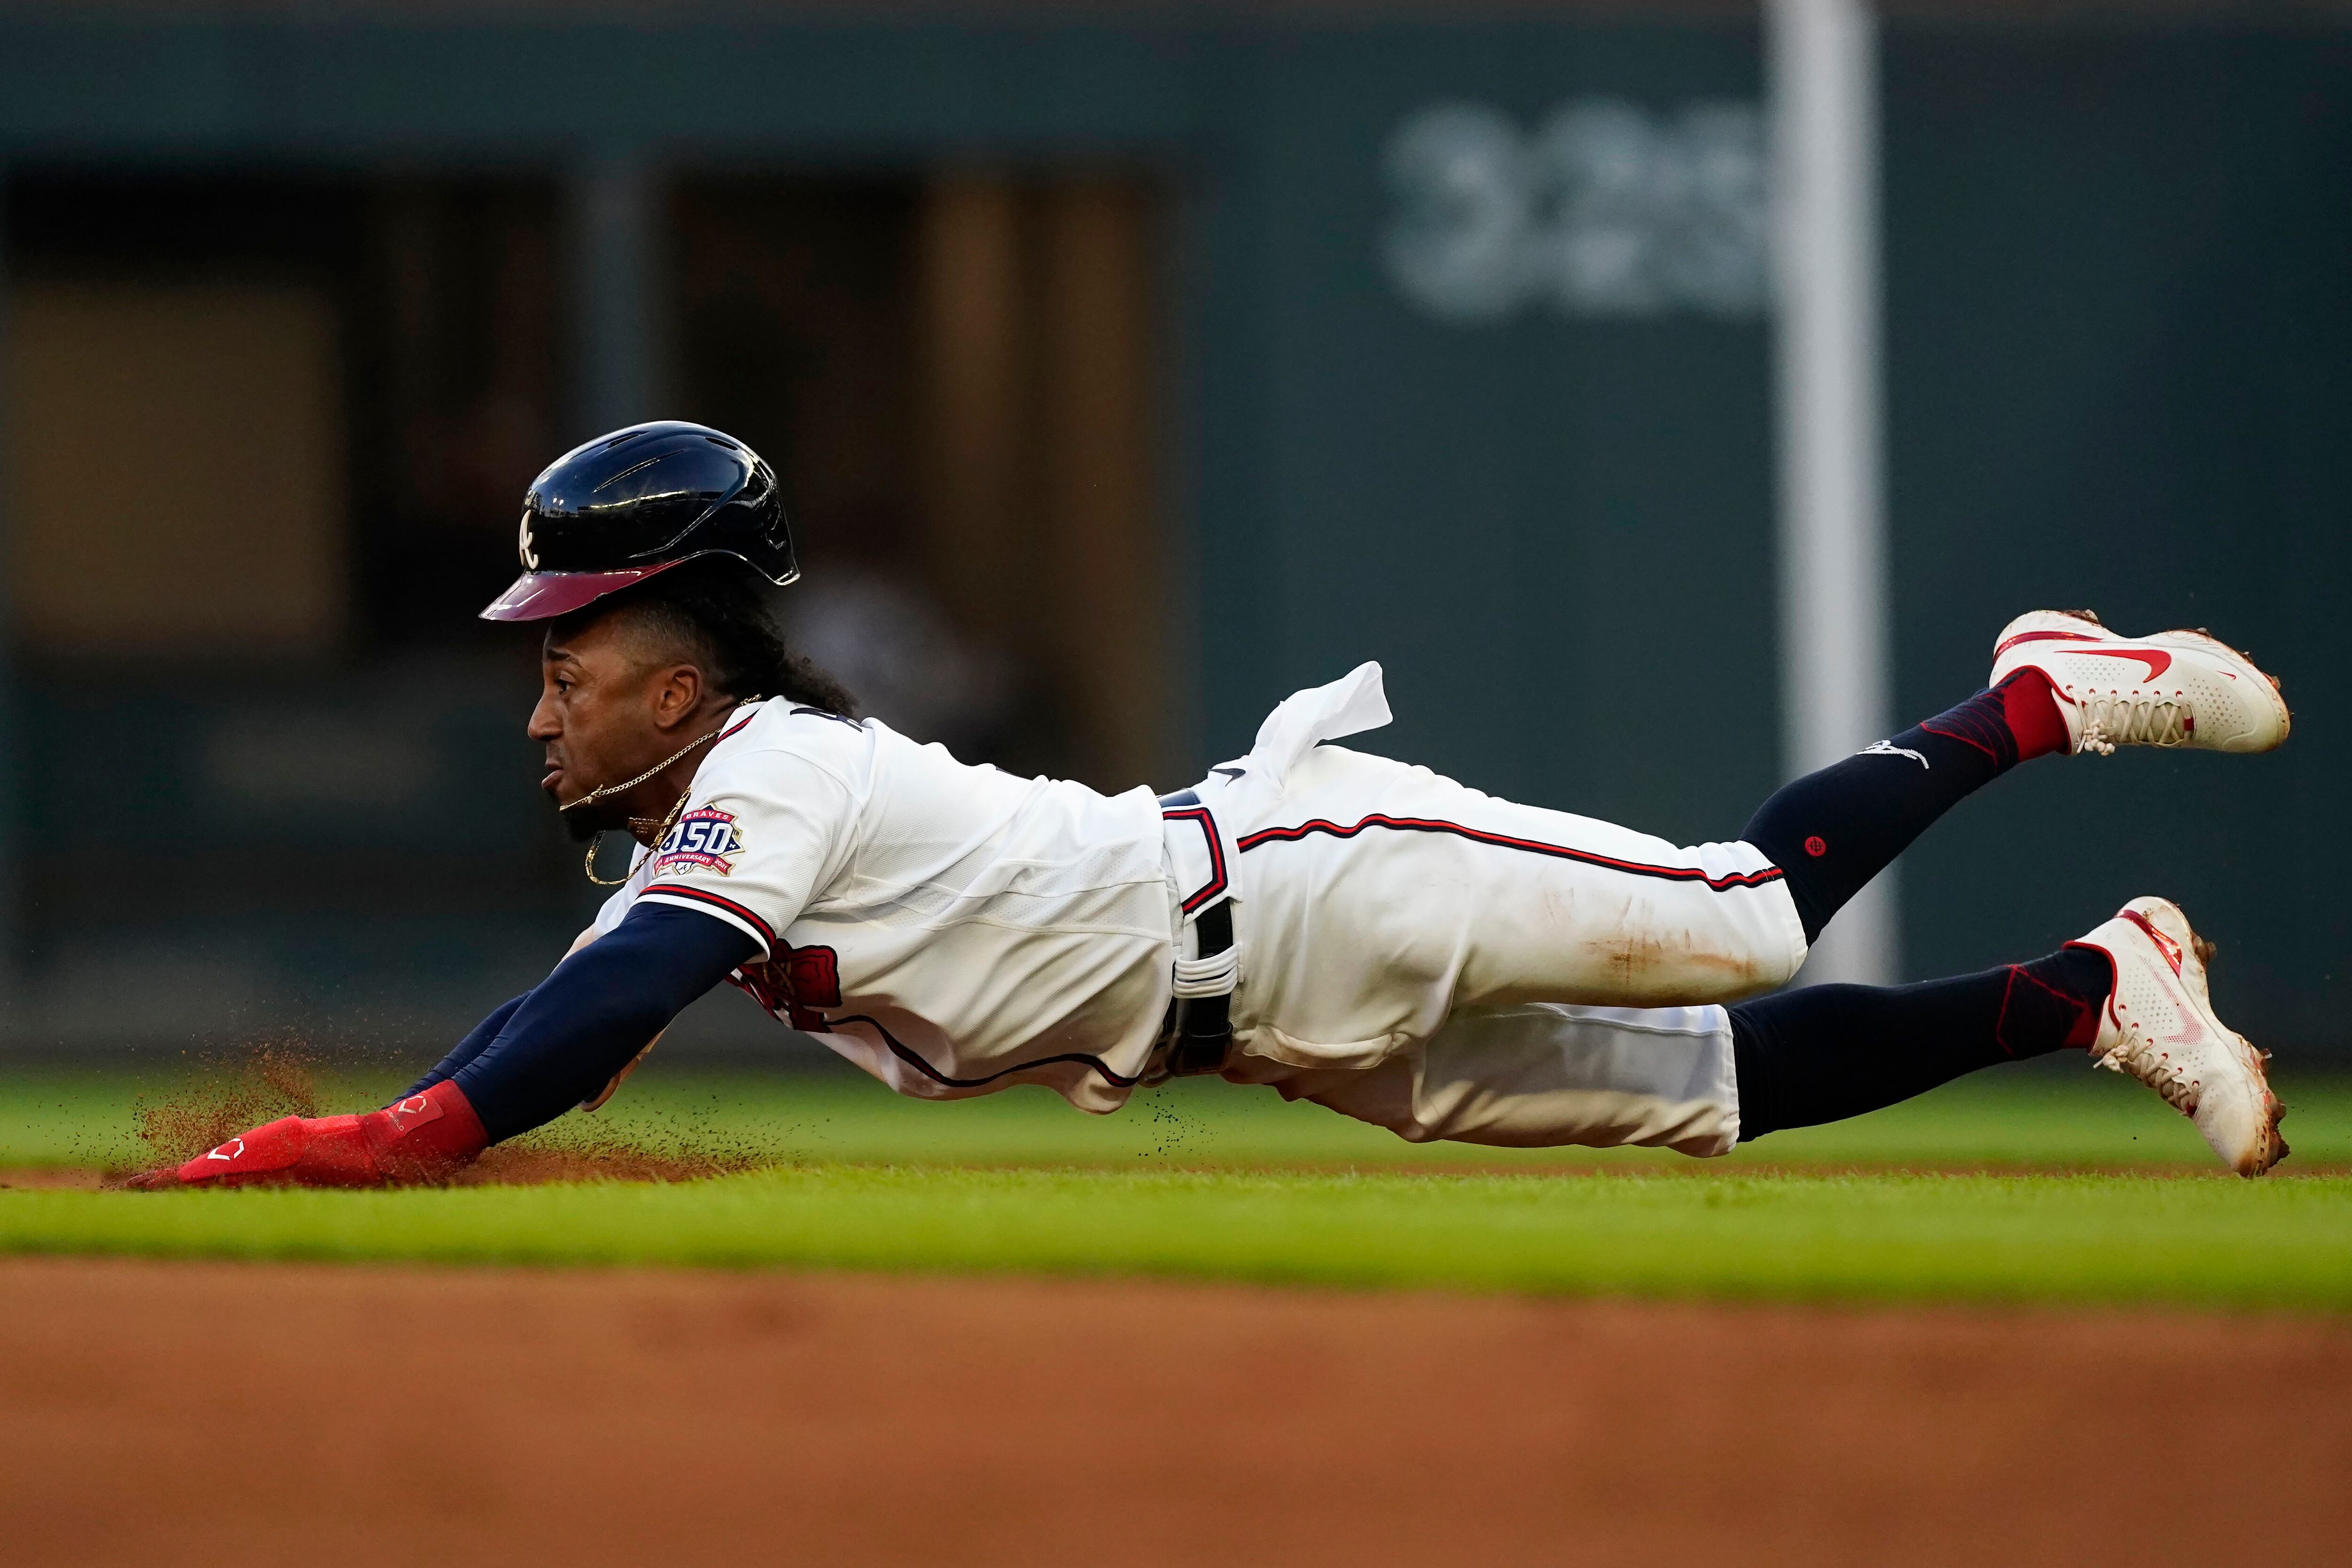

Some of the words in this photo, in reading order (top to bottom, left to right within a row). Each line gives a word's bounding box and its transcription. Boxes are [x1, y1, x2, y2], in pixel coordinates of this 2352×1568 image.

[685, 811, 729, 820] BRAVES
[662, 822, 734, 854] 150
[664, 854, 711, 864] ANNIVERSARY
[714, 859, 728, 870] 2021
